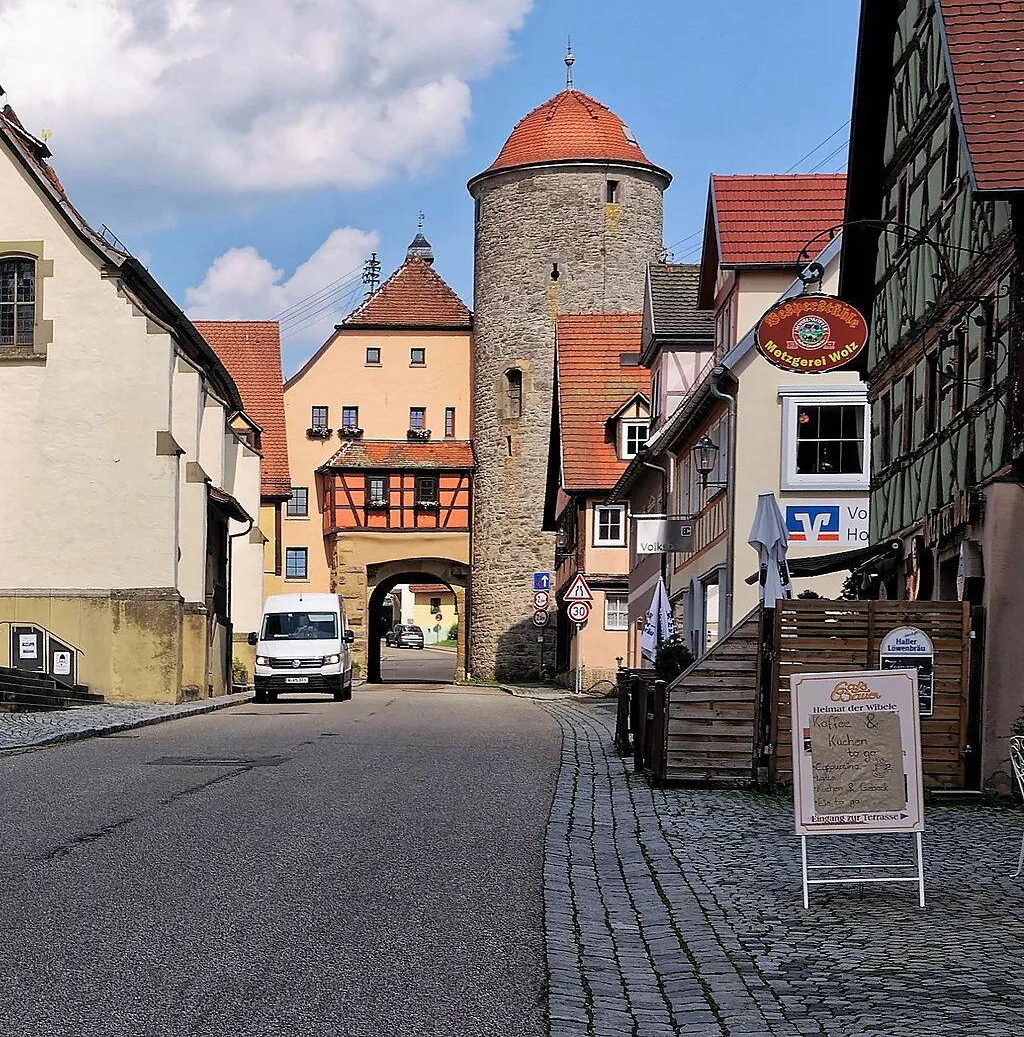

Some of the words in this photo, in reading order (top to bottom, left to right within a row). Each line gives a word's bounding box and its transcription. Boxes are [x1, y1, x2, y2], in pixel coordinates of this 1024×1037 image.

[764, 340, 827, 367] Metzgerei
[829, 341, 859, 362] Wolz
[847, 506, 867, 519] Vo
[847, 528, 869, 541] Ho
[573, 606, 585, 616] 30
[887, 644, 926, 652] Löwenbräu
[848, 704, 863, 712] der
[865, 703, 897, 711] Wibele
[812, 715, 851, 730] Kaffee
[866, 713, 878, 729] &
[827, 733, 868, 747] Kuchen
[846, 747, 859, 758] to
[863, 749, 878, 762] go
[816, 783, 843, 793] Kuchen
[847, 783, 856, 792] &
[849, 799, 860, 809] go
[811, 814, 846, 823] Eingang
[846, 814, 861, 822] zur
[862, 813, 899, 821] Terrasse
